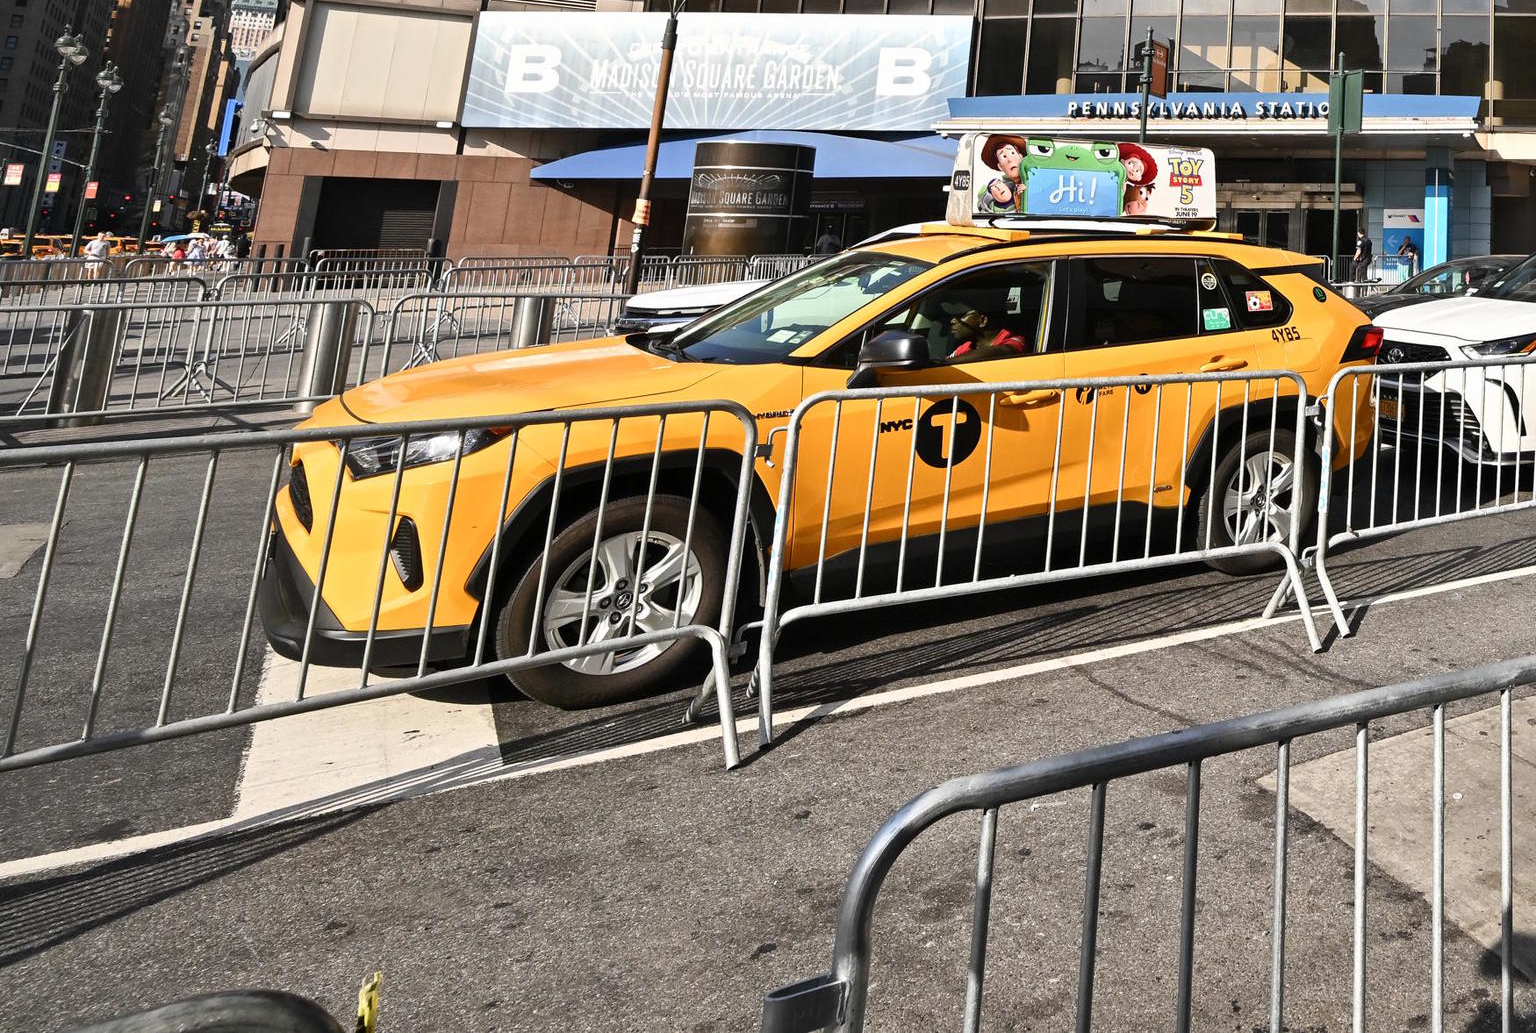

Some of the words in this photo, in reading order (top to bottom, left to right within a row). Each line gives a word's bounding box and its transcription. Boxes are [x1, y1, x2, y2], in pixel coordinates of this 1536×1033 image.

[503, 44, 562, 93] B
[683, 59, 757, 90] SQUARE
[876, 46, 933, 96] B
[1067, 101, 1244, 116] PENNSYLVANIA
[1255, 101, 1329, 116] STATIO
[1168, 157, 1205, 177] TOY
[953, 173, 971, 189] 4Y85
[1049, 173, 1097, 205] Hi!
[1173, 176, 1200, 184] STORY
[719, 190, 753, 205] SQUARE
[1180, 184, 1193, 205] 5
[880, 418, 913, 434] NYC
